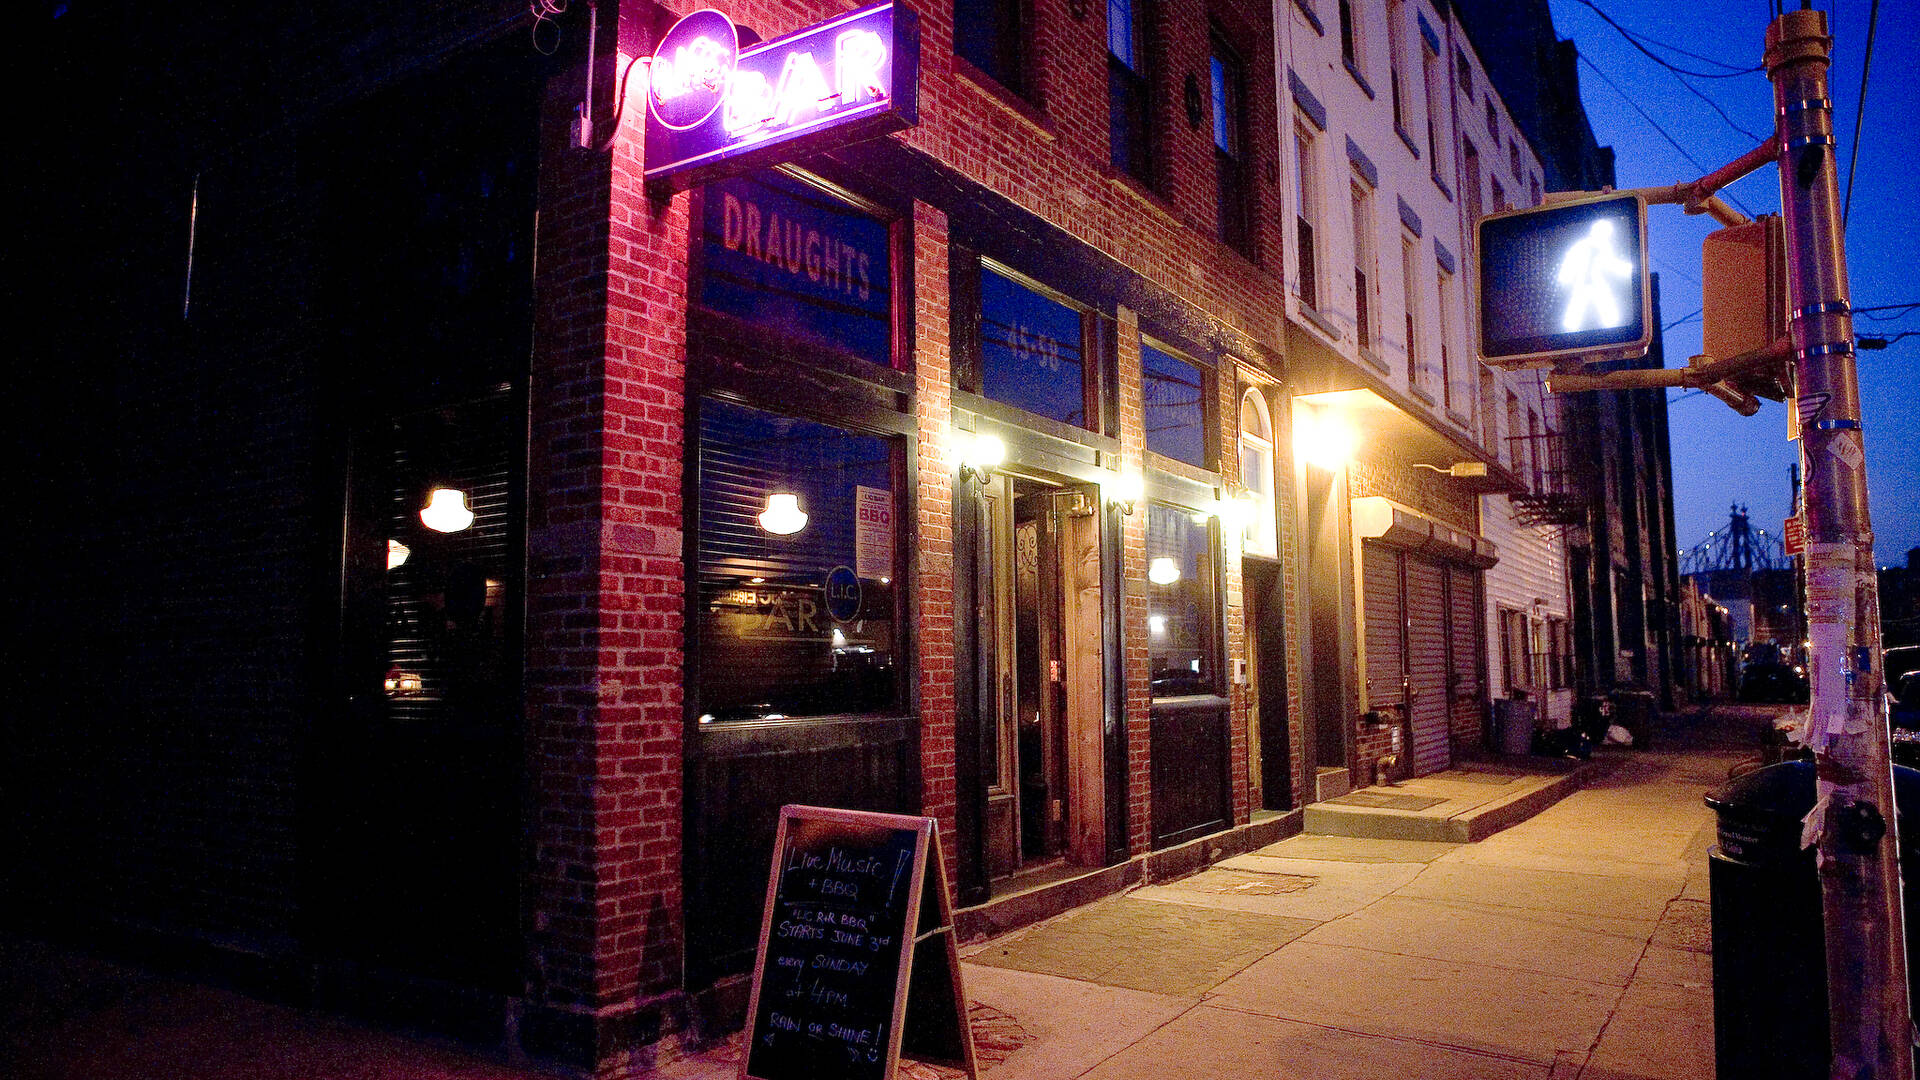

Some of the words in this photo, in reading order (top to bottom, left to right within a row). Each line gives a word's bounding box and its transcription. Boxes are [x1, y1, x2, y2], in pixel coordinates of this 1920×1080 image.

[723, 29, 888, 138] BAR
[724, 192, 870, 301] DRAUGHTS
[859, 508, 890, 525] BBQ
[787, 847, 821, 872] Live
[821, 879, 859, 900] BBQ
[778, 920, 824, 940] STARTS
[831, 929, 862, 946] JUNE
[869, 935, 892, 951] 3rd
[811, 953, 869, 977] SUNDAY
[770, 1011, 802, 1033] RAIN
[807, 1022, 823, 1034] OR
